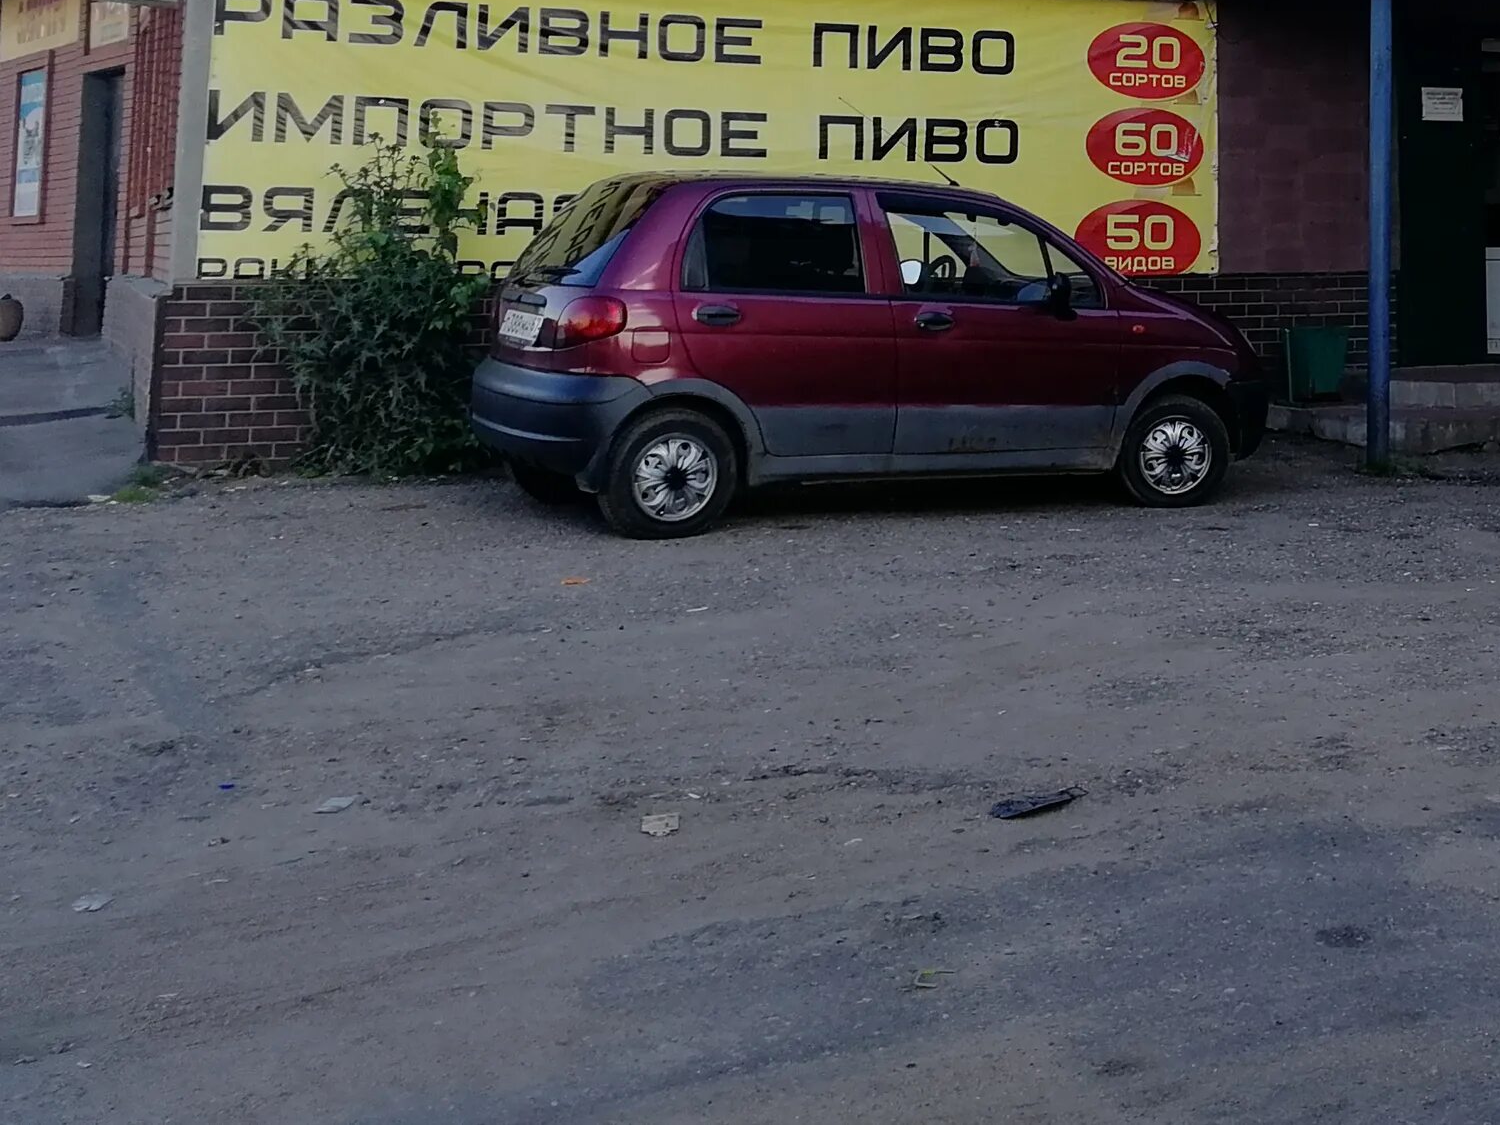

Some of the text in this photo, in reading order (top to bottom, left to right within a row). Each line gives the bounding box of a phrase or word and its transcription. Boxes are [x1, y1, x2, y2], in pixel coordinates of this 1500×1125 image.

[812, 22, 1015, 75] ПИВО
[1115, 34, 1181, 69] 20
[1109, 72, 1187, 88] СОРТОВ
[206, 89, 1020, 165] ИМПОРТНОЕ ПИВО
[1114, 123, 1179, 157] 60
[1107, 161, 1185, 176] СОРТОВ
[1106, 214, 1175, 251] 50
[1104, 256, 1175, 272] ВИДОВ
